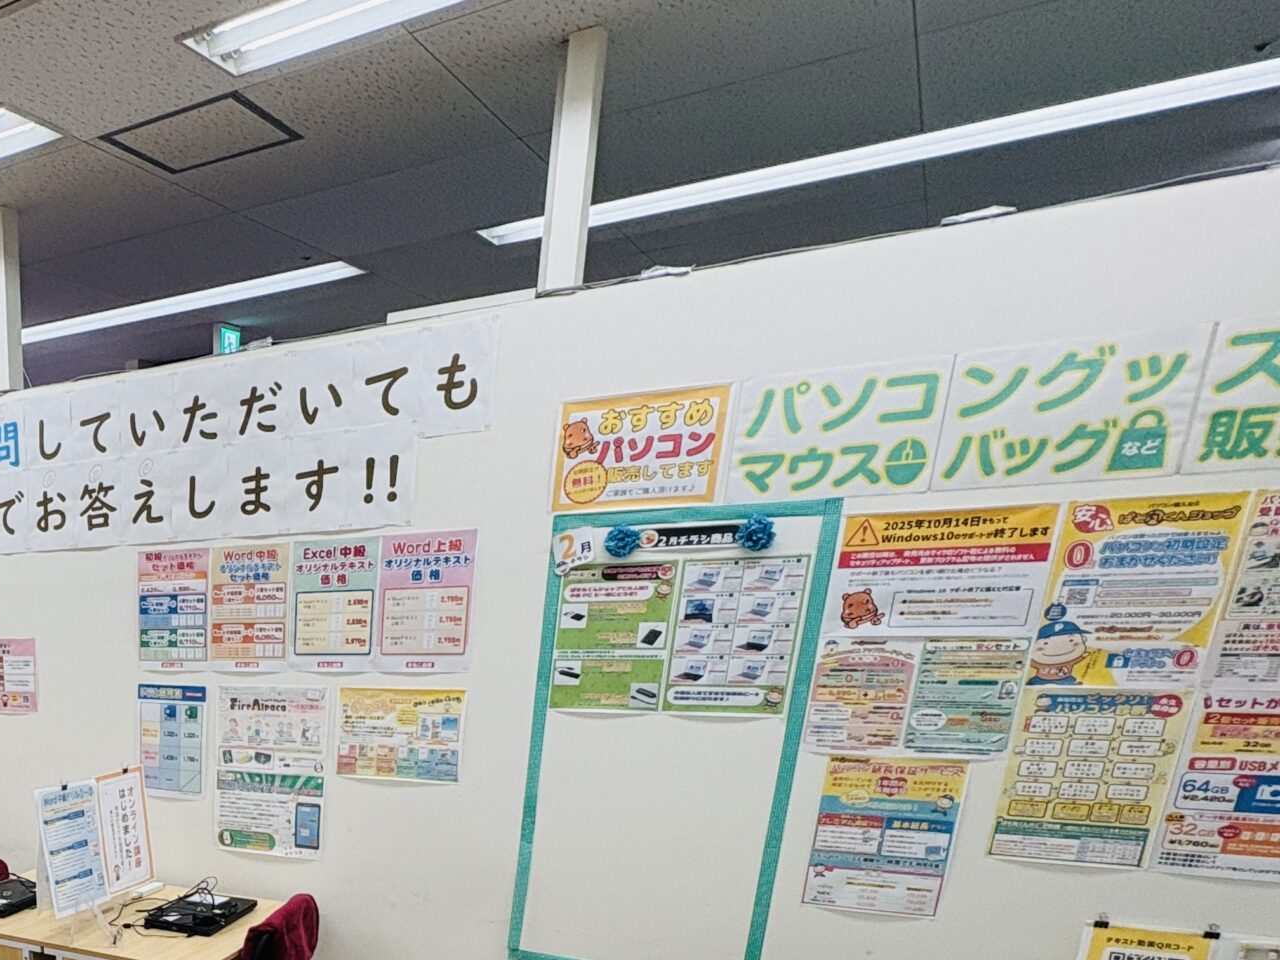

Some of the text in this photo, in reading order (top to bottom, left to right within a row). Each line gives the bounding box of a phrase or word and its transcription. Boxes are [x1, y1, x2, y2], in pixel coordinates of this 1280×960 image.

[598, 399, 714, 435] おすすめ
[1200, 404, 1280, 461] 販
[596, 431, 716, 464] パソコン
[942, 416, 1161, 480] バッグ など
[608, 460, 714, 484] 販売してます
[739, 445, 880, 494] マウス
[883, 516, 1009, 531] 2025年10月14日をもって
[881, 526, 1051, 543] Windows10のサポートが終了します
[303, 544, 366, 560] Excel 中級
[393, 539, 463, 555] Word 上級
[558, 533, 592, 557] 2月
[223, 549, 278, 561] Word 中級
[384, 556, 471, 569] オリジナルテキスト
[151, 561, 195, 571] セット価格
[296, 561, 375, 573] オリジナルテキスト
[229, 572, 270, 582] セット価格
[411, 569, 441, 582] 価格
[229, 697, 287, 712] FireAlpaca
[1238, 760, 1280, 772] USBメ
[1181, 779, 1230, 795] 64GB
[127, 785, 143, 868] オンライン講座
[1169, 823, 1216, 838] 32GB
[1105, 936, 1194, 952] テキスト動画QRコード
